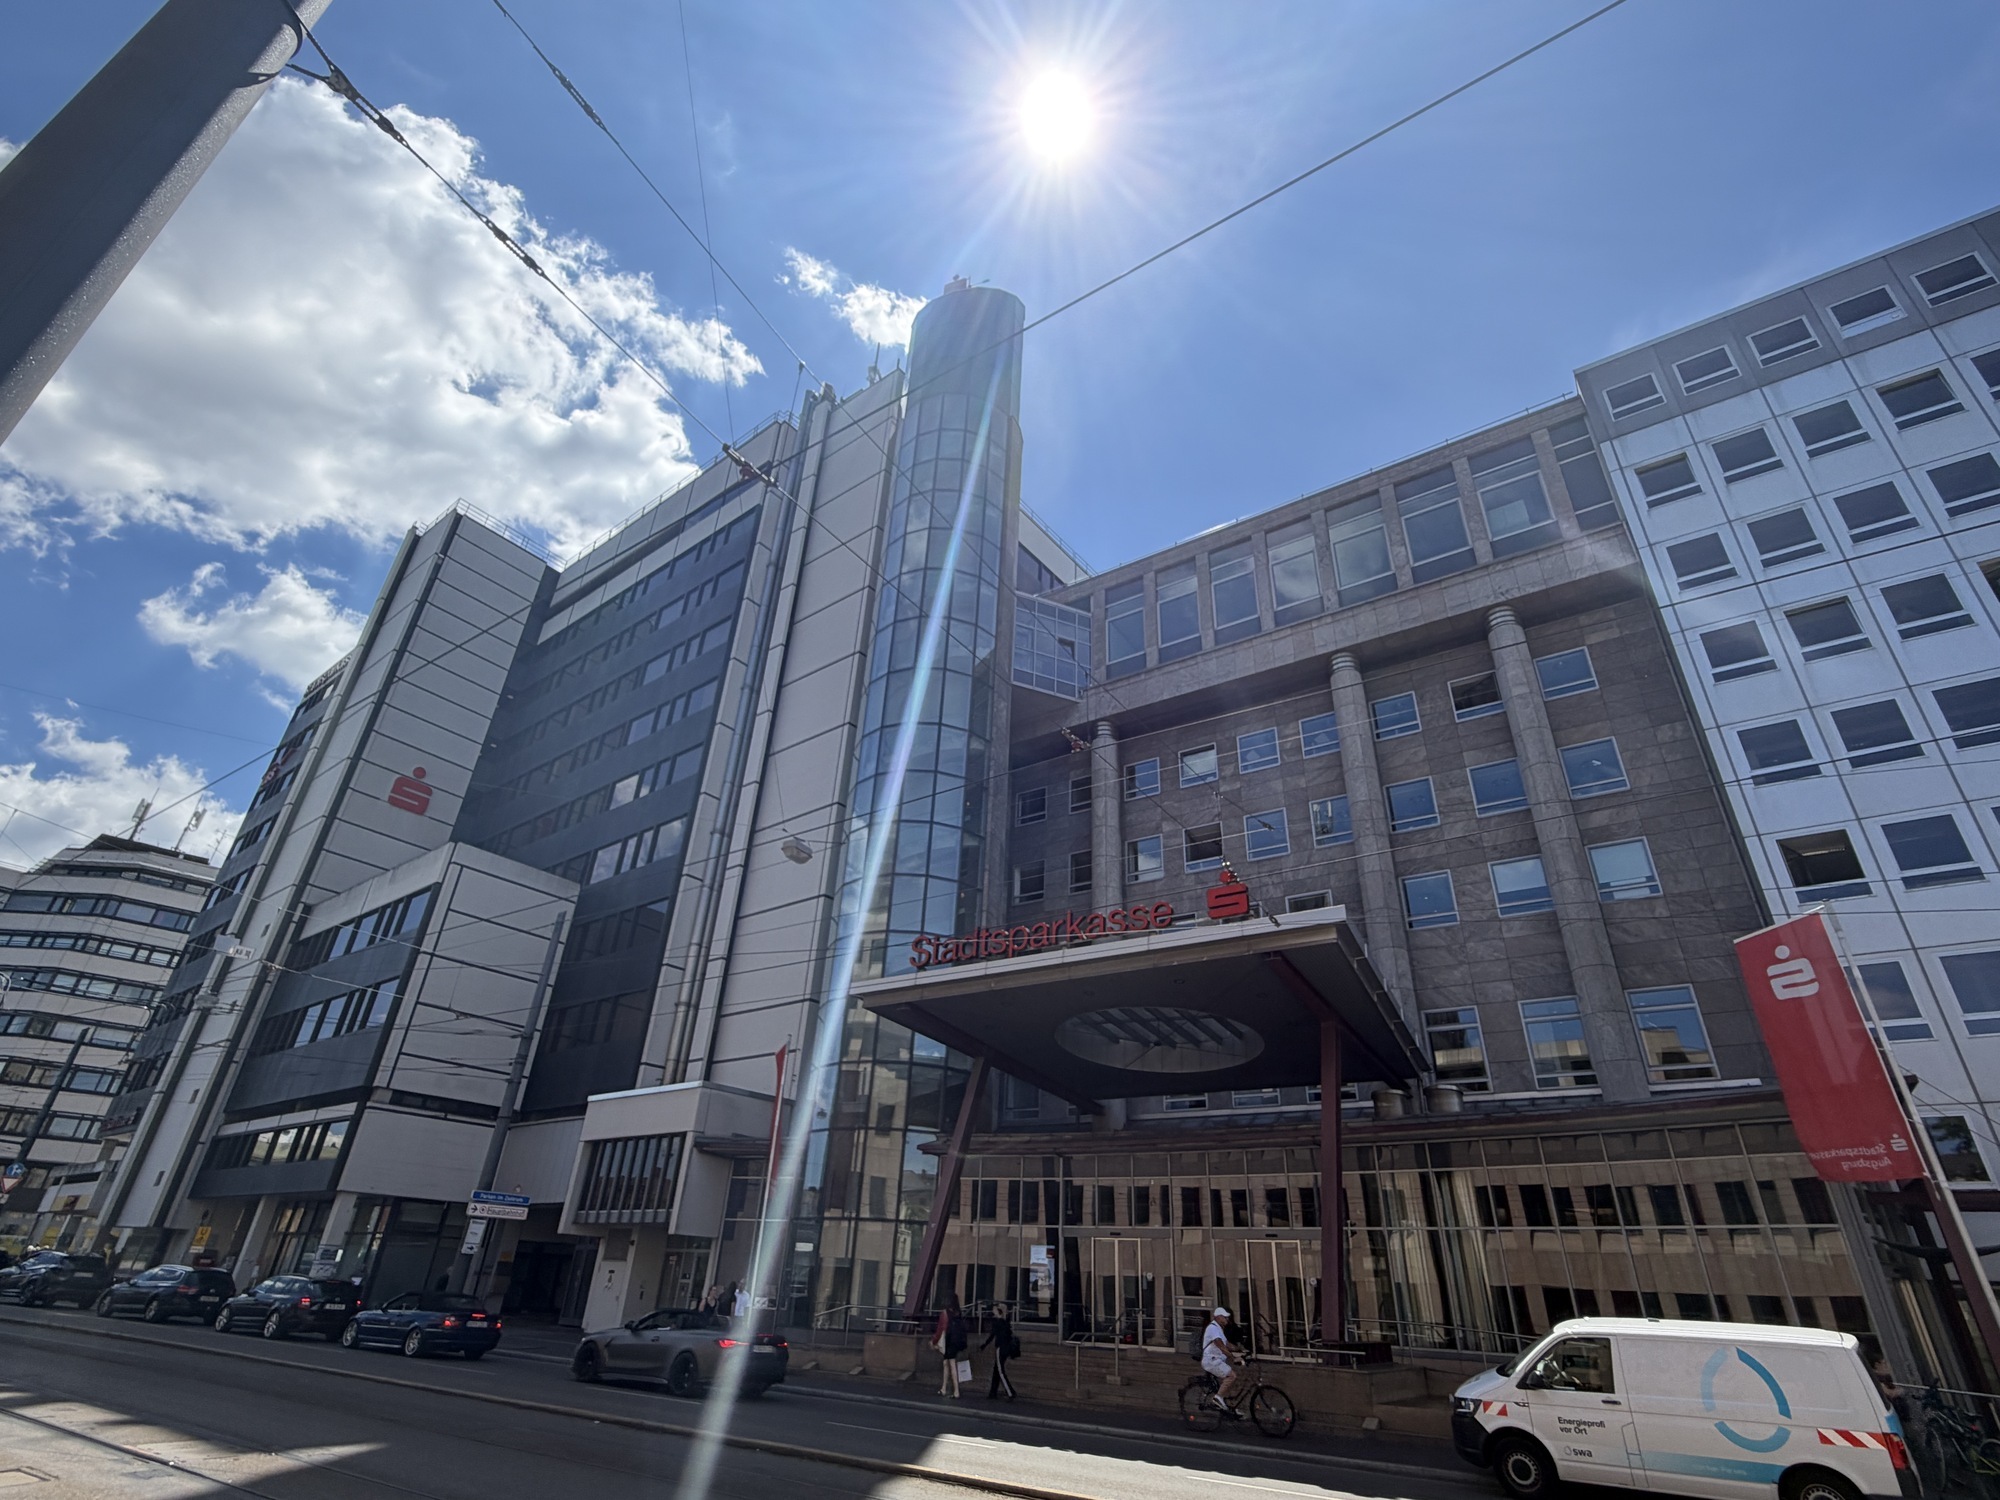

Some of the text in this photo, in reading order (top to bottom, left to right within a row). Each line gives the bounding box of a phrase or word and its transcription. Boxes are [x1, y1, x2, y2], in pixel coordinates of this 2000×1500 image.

[909, 901, 1174, 969] Stadtsparkasse
[1557, 1417, 1605, 1428] Energieprofi
[1574, 1427, 1588, 1435] Ort
[1572, 1448, 1592, 1457] swa
